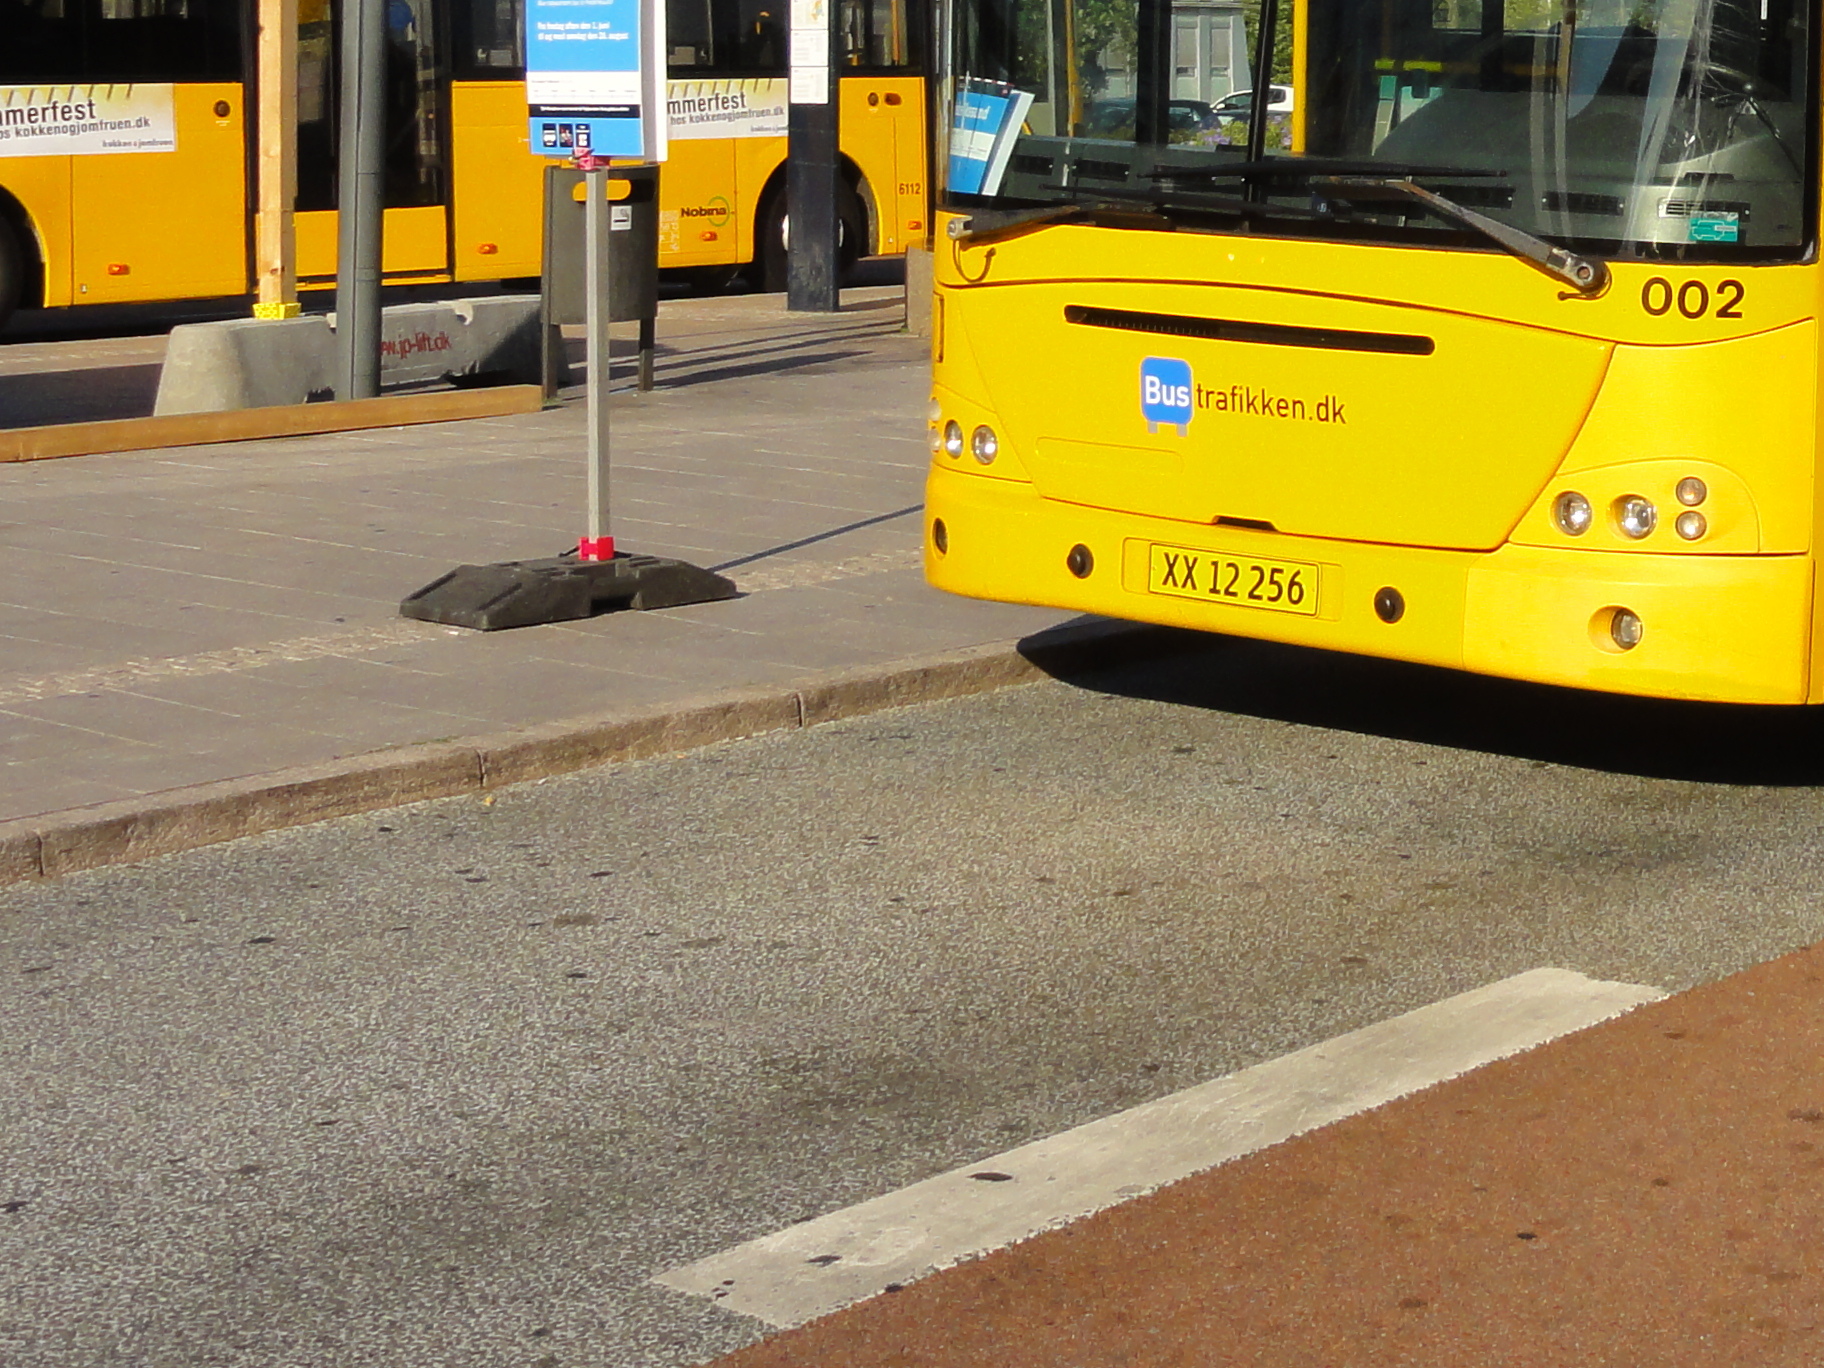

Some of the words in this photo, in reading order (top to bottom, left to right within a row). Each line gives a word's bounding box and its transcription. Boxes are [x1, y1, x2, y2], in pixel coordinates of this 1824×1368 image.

[0, 99, 96, 126] merfest
[899, 183, 921, 195] 6112
[680, 206, 726, 218] Nobina
[1641, 276, 1745, 320] 002
[1162, 552, 1198, 590] XX
[1209, 560, 1240, 597] 12
[1248, 565, 1304, 605] 256
